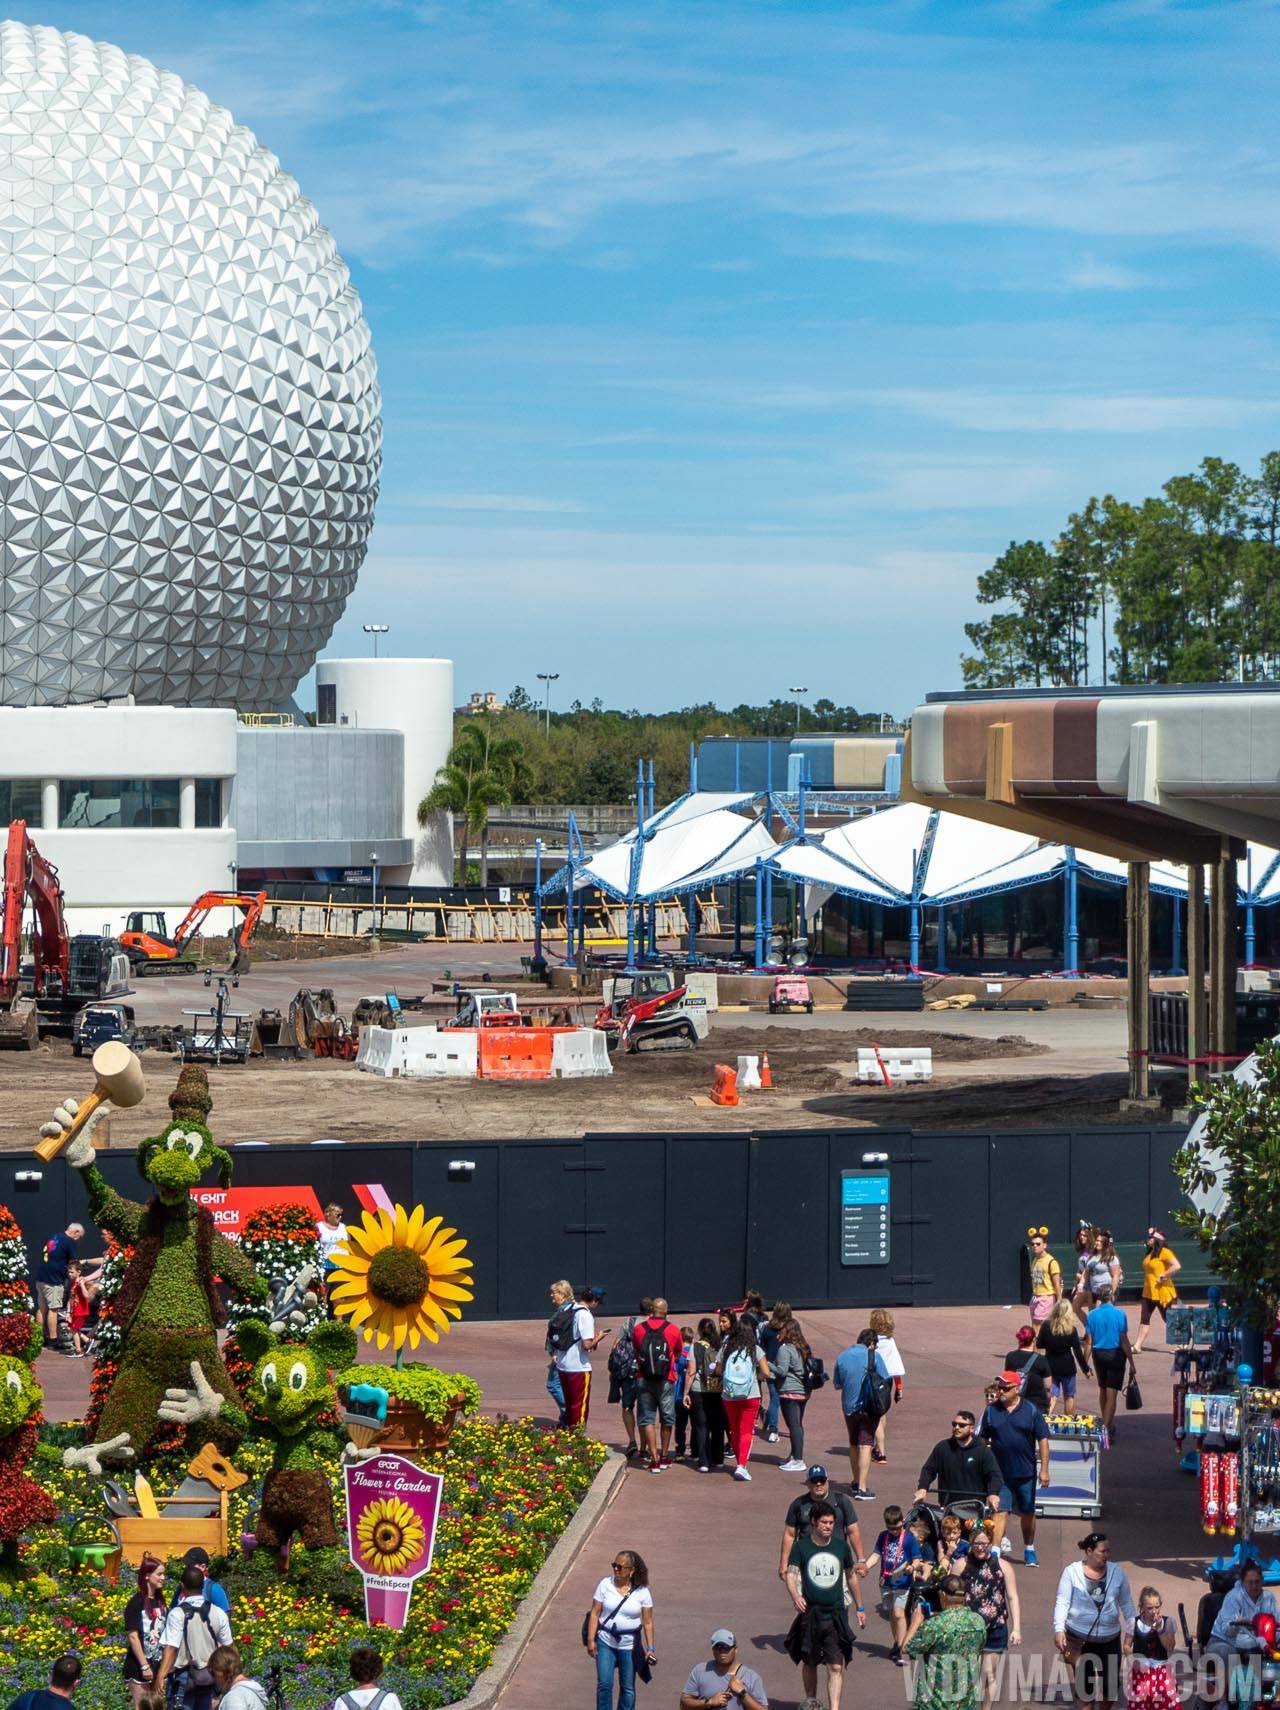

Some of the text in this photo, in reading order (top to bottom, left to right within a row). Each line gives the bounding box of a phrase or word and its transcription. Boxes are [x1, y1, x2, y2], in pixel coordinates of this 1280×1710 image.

[502, 890, 508, 899] 7
[200, 1193, 227, 1204] EXIT
[378, 1460, 401, 1470] EPCOT
[352, 1471, 383, 1489] Flower
[393, 1477, 432, 1493] Garden
[366, 1576, 410, 1589] #FreshEpcot
